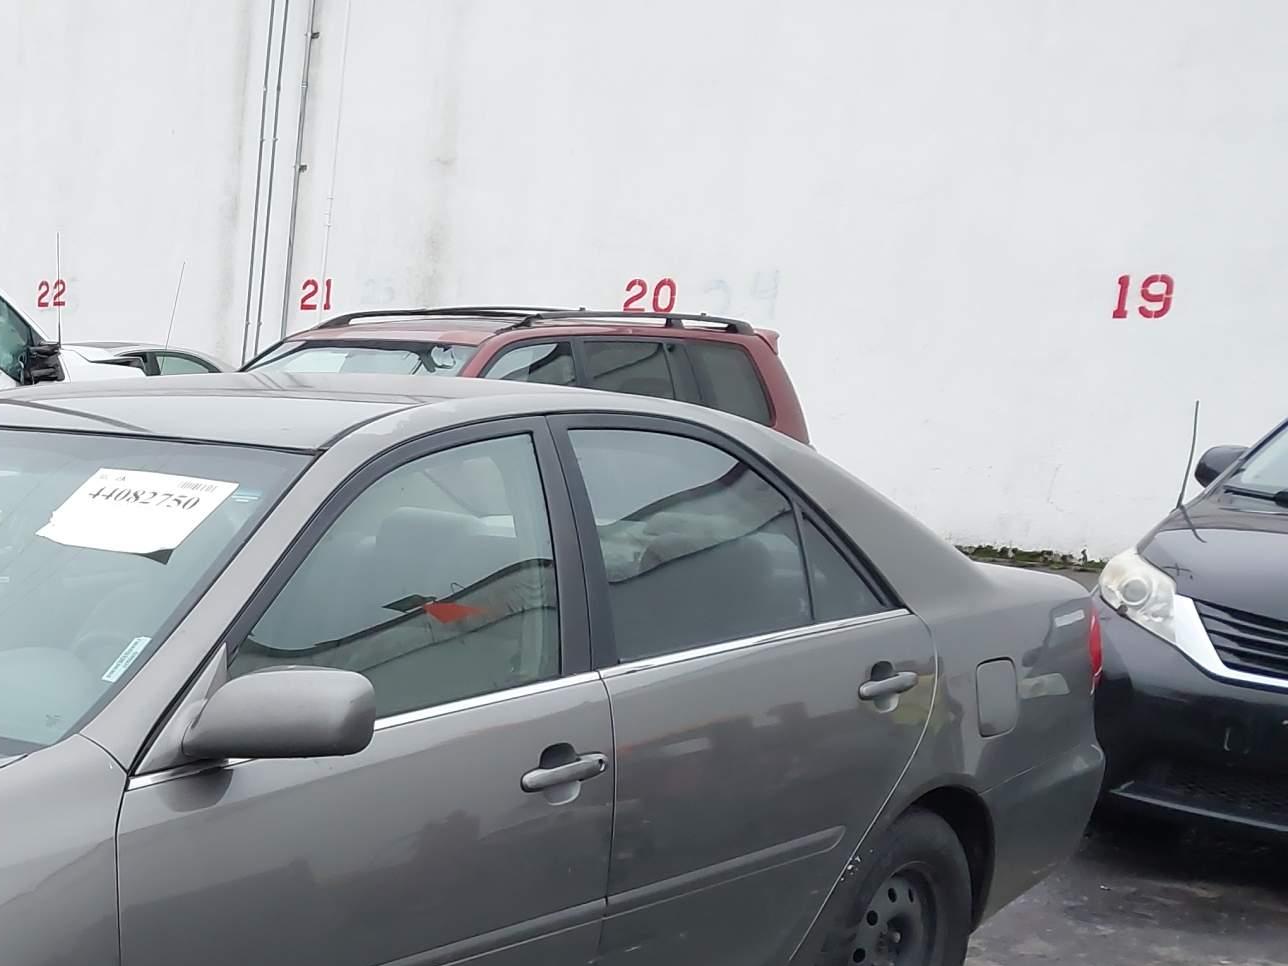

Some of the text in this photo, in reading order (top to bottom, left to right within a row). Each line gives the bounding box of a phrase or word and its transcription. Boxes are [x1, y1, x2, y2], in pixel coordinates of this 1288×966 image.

[37, 278, 67, 308] 22
[299, 278, 333, 311] 21
[623, 277, 677, 313] 20
[1111, 273, 1175, 319] 19
[88, 486, 200, 510] 44082750
